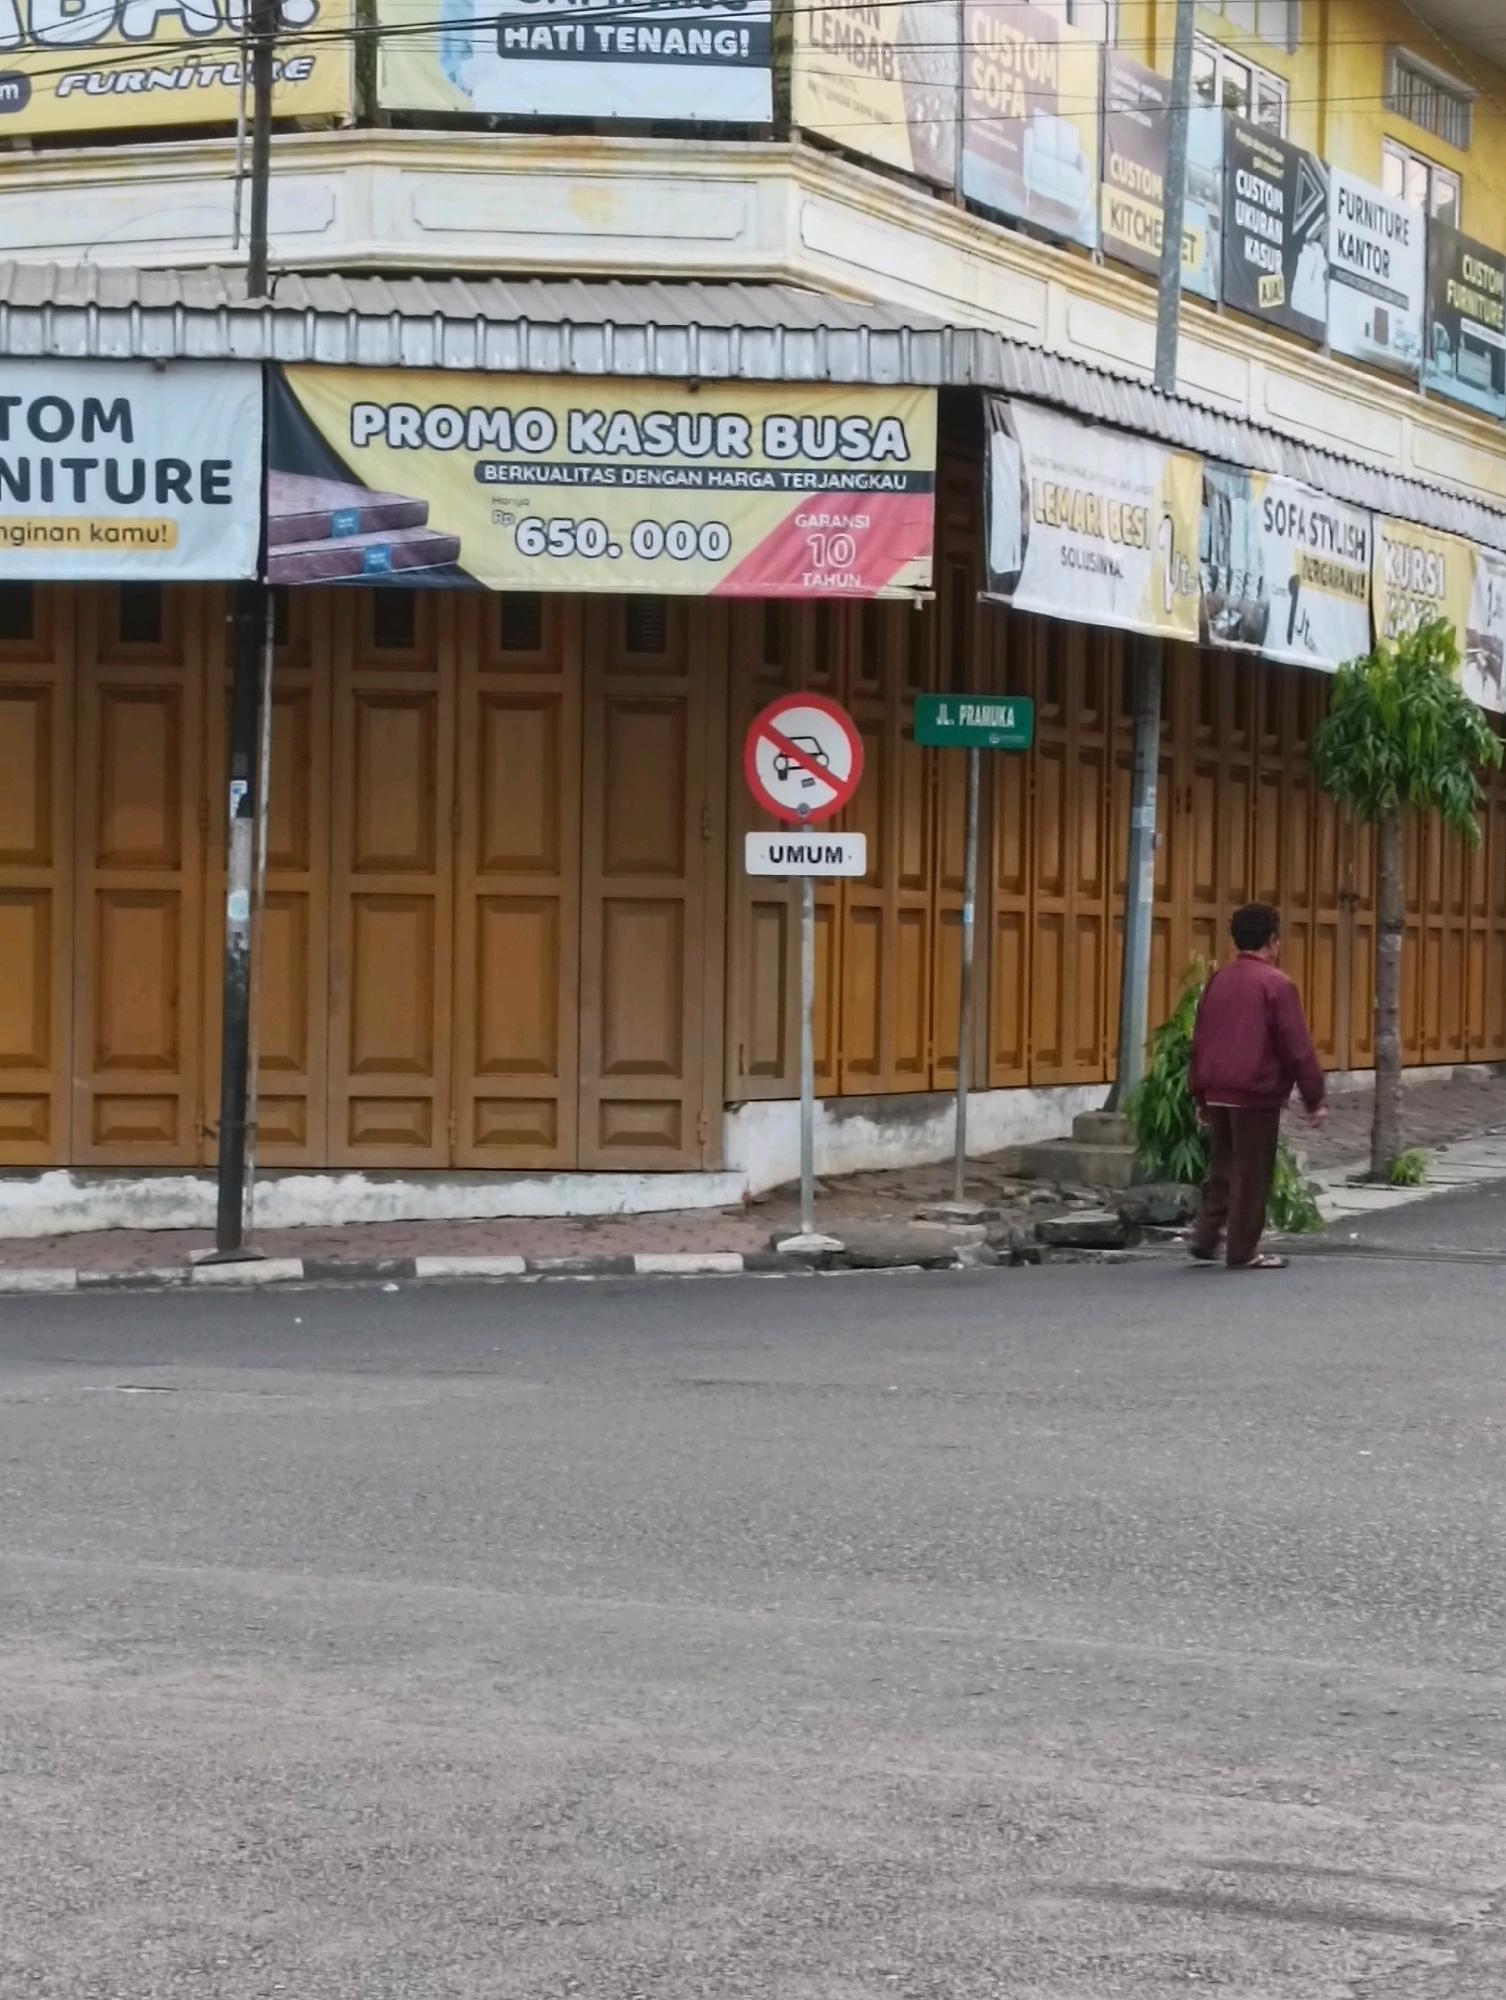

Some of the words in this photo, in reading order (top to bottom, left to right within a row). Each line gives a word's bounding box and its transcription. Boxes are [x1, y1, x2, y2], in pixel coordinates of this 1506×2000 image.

[503, 24, 586, 51] HATI
[593, 25, 750, 58] TENANG!
[971, 8, 1058, 90] CUSTOM
[971, 56, 1027, 123] SOFA
[1110, 153, 1163, 201] CUSTOM
[1235, 168, 1284, 215] CUSTOM
[1109, 197, 1164, 252] KITCHE
[1235, 198, 1284, 246] UKURAN
[1338, 186, 1410, 247] FURNITURE
[1244, 234, 1284, 277] KASUR
[1337, 227, 1390, 279] KANTOR
[0, 395, 134, 443] TOM
[349, 402, 557, 451] PROMO
[567, 410, 751, 458] KASUR
[763, 413, 910, 462] BUSA
[0, 456, 233, 505] NITURE
[484, 464, 616, 484] BERKUALITAS
[621, 467, 703, 486] DENGAN
[708, 470, 776, 488] HARGA
[780, 472, 907, 490] TERJANGKAU
[90, 522, 168, 544] kamu!
[794, 513, 870, 529] GARANSI
[1107, 498, 1151, 551] BESI
[1263, 496, 1307, 543] SOFA
[806, 532, 857, 569] 10
[1384, 538, 1447, 602] KURSI
[802, 572, 861, 588] TAHUN
[936, 703, 955, 726] JL.
[959, 704, 1016, 729] PRAMUKA
[768, 845, 844, 865] UMUM
